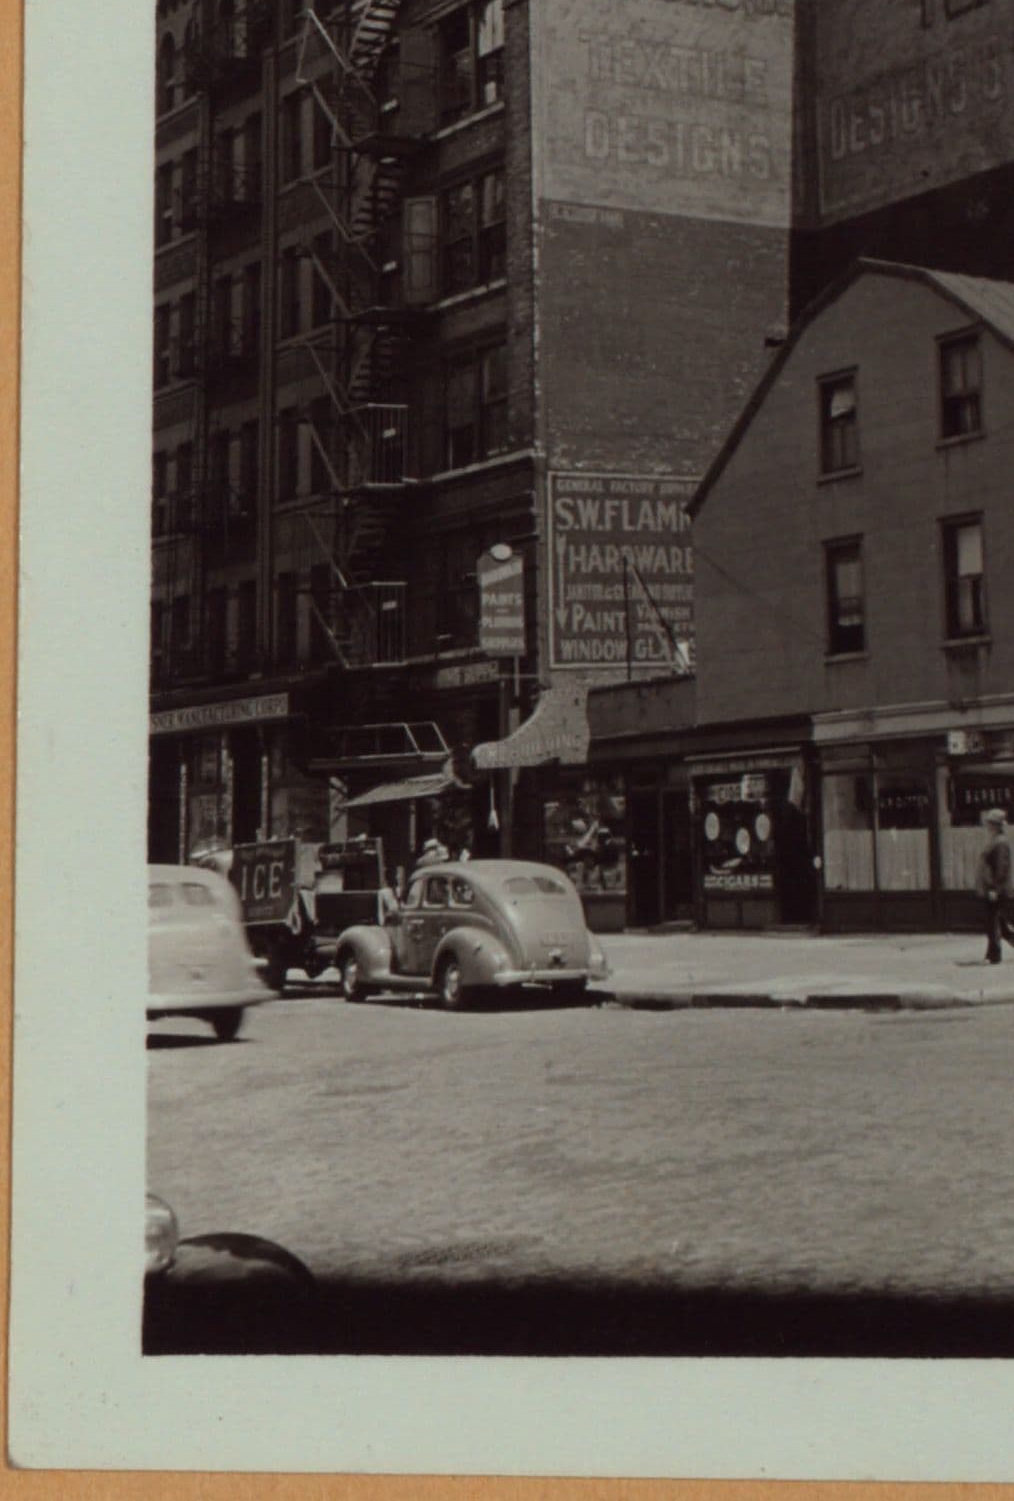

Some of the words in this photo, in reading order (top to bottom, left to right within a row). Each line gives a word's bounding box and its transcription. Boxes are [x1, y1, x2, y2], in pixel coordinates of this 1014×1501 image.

[581, 108, 778, 186] DESIGNS
[568, 544, 693, 574] HARDWARE
[571, 603, 627, 633] PAINT
[560, 639, 627, 661] WINDOW
[241, 861, 285, 902] ICE
